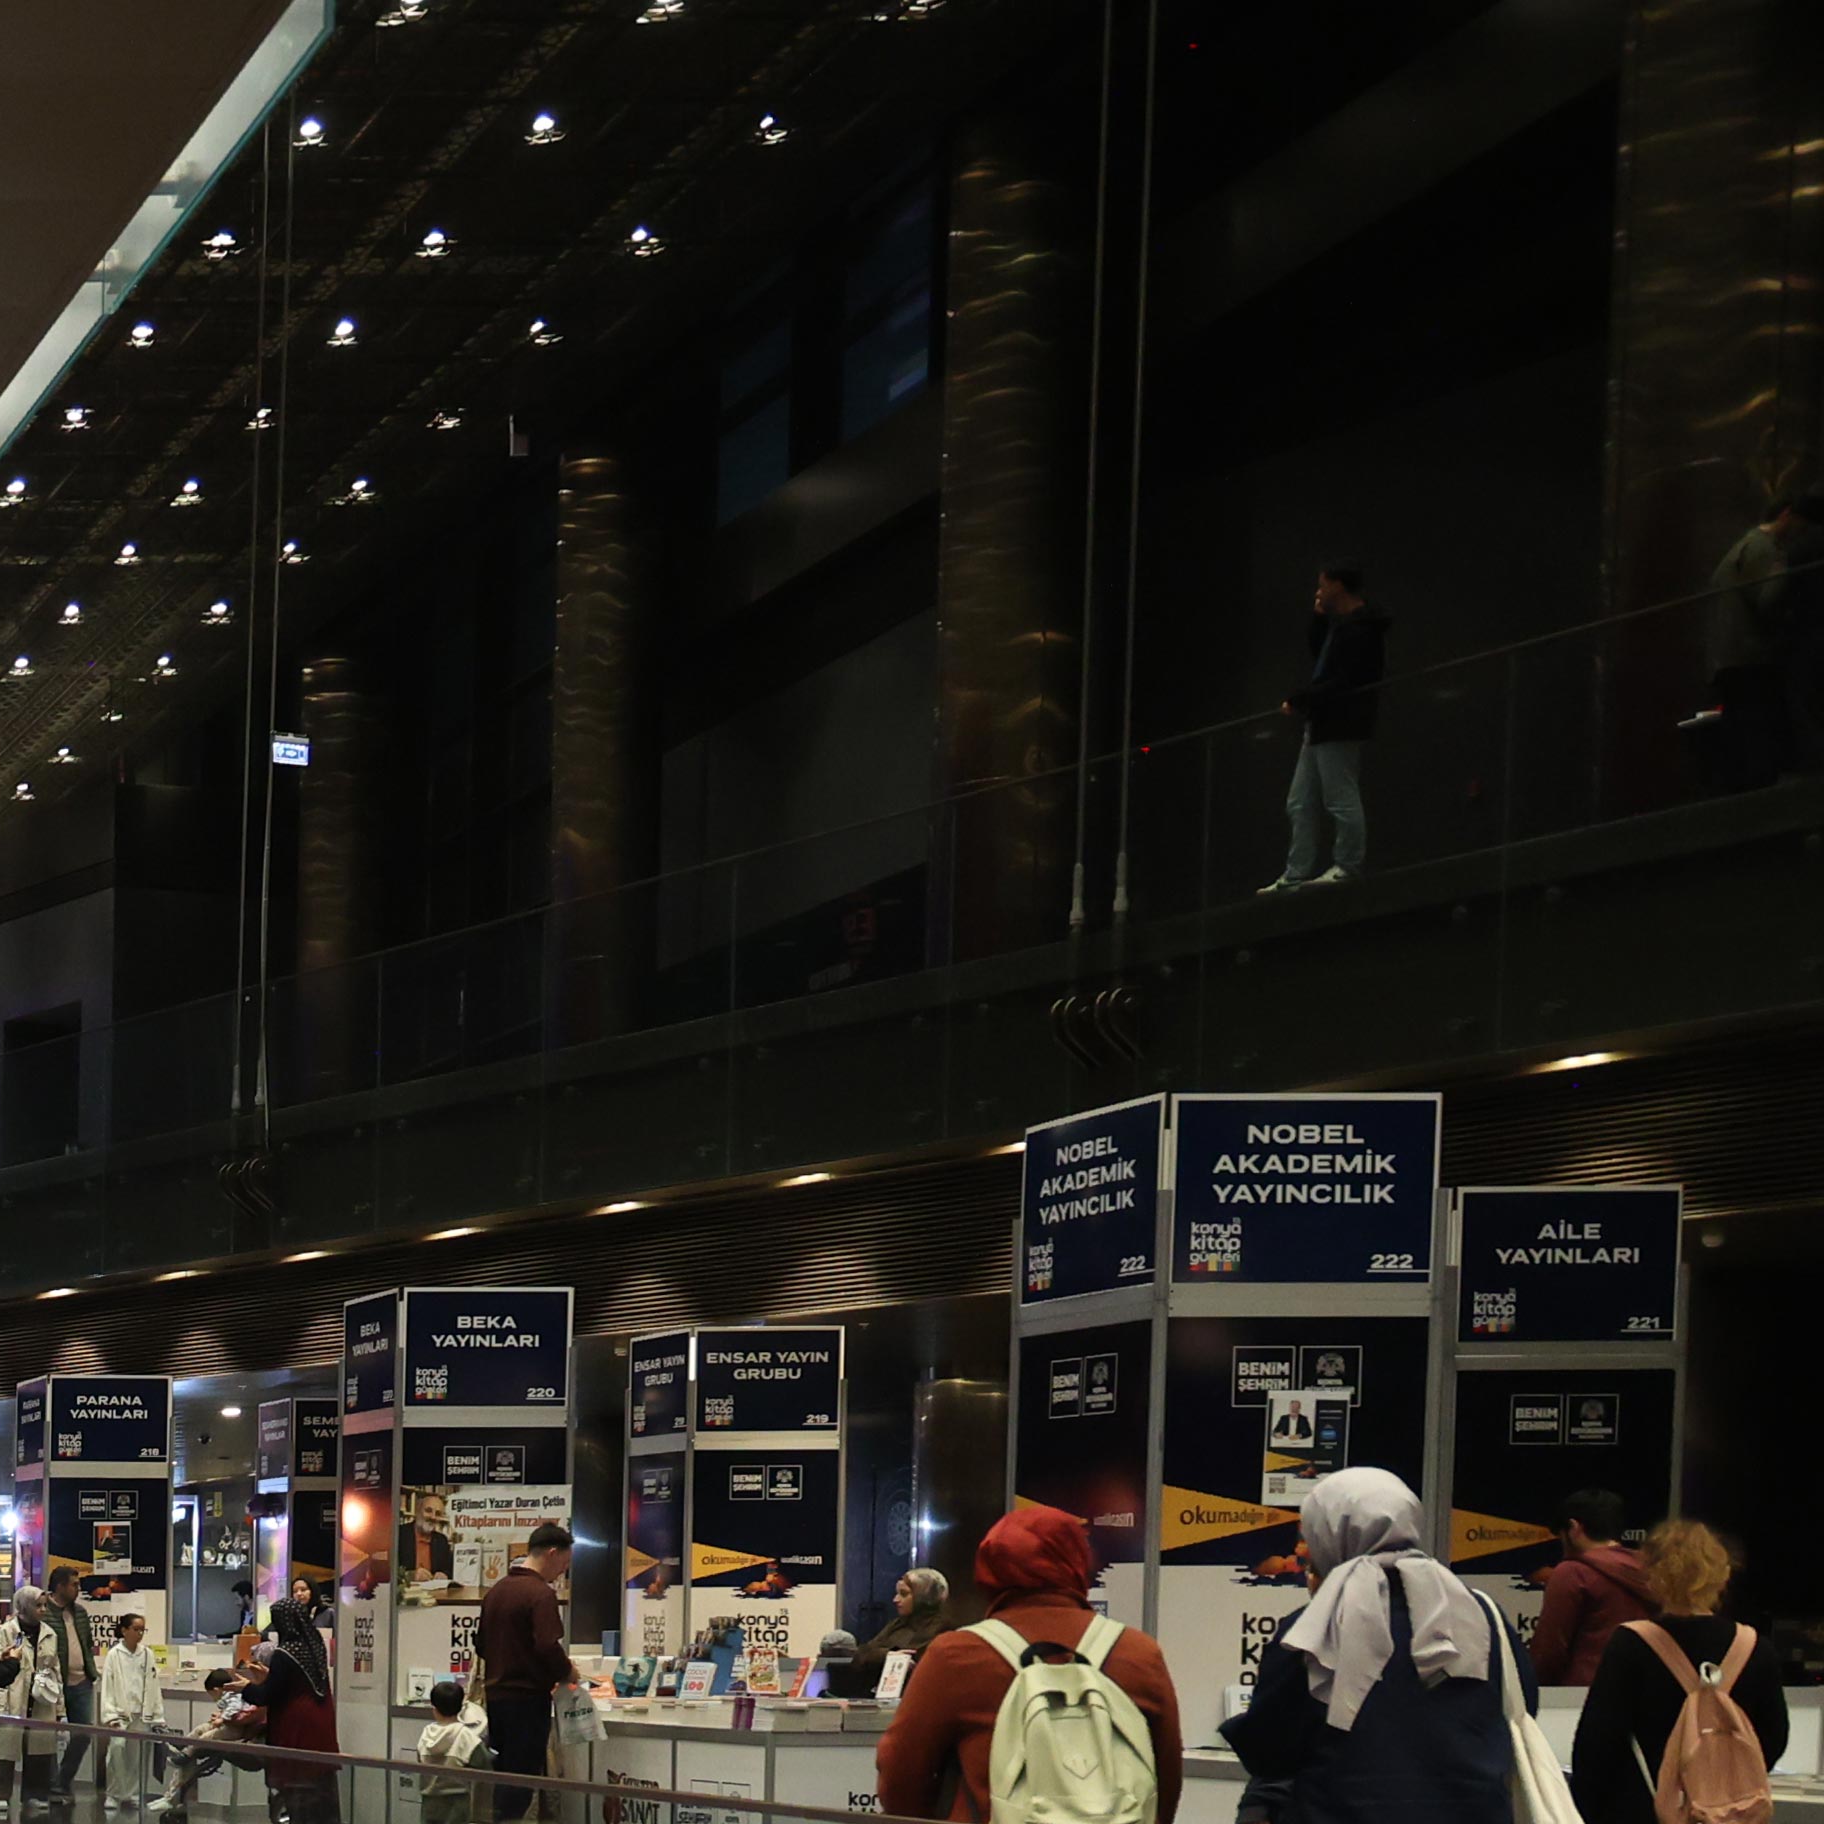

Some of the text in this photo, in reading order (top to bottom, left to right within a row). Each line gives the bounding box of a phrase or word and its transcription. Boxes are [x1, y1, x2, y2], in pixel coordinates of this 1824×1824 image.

[1247, 1124, 1364, 1144] NOBEL
[1056, 1136, 1118, 1167] NOBEL
[1212, 1149, 1396, 1174] AKADEMİK
[1039, 1157, 1136, 1198] AKADEMİK
[1212, 1184, 1395, 1203] YAYINCILIK
[1039, 1189, 1135, 1226] YAYINCILIK
[1191, 1221, 1241, 1236] konya
[1537, 1219, 1601, 1240] AİLE
[1191, 1235, 1240, 1251] kitap
[1370, 1254, 1413, 1269] 222
[1496, 1248, 1640, 1264] YAYINLARI
[1120, 1256, 1146, 1272] 222
[360, 1321, 380, 1338] BEKA
[456, 1316, 517, 1329] BEKA
[1628, 1317, 1660, 1329] 221
[352, 1338, 388, 1357] YAYINLARI
[431, 1334, 540, 1348] YAYINLARI
[634, 1354, 685, 1373] ENSAR YAYIN
[706, 1351, 829, 1364] ENSAR YAYIN
[644, 1372, 674, 1386] GRUBU
[733, 1368, 801, 1380] GRUBU
[76, 1395, 142, 1406] PARANA
[527, 1388, 555, 1398] 220
[70, 1409, 148, 1420] YAYINLARI
[806, 1414, 829, 1423] 219
[489, 1497, 513, 1509] Yazar
[515, 1497, 540, 1509] Duran
